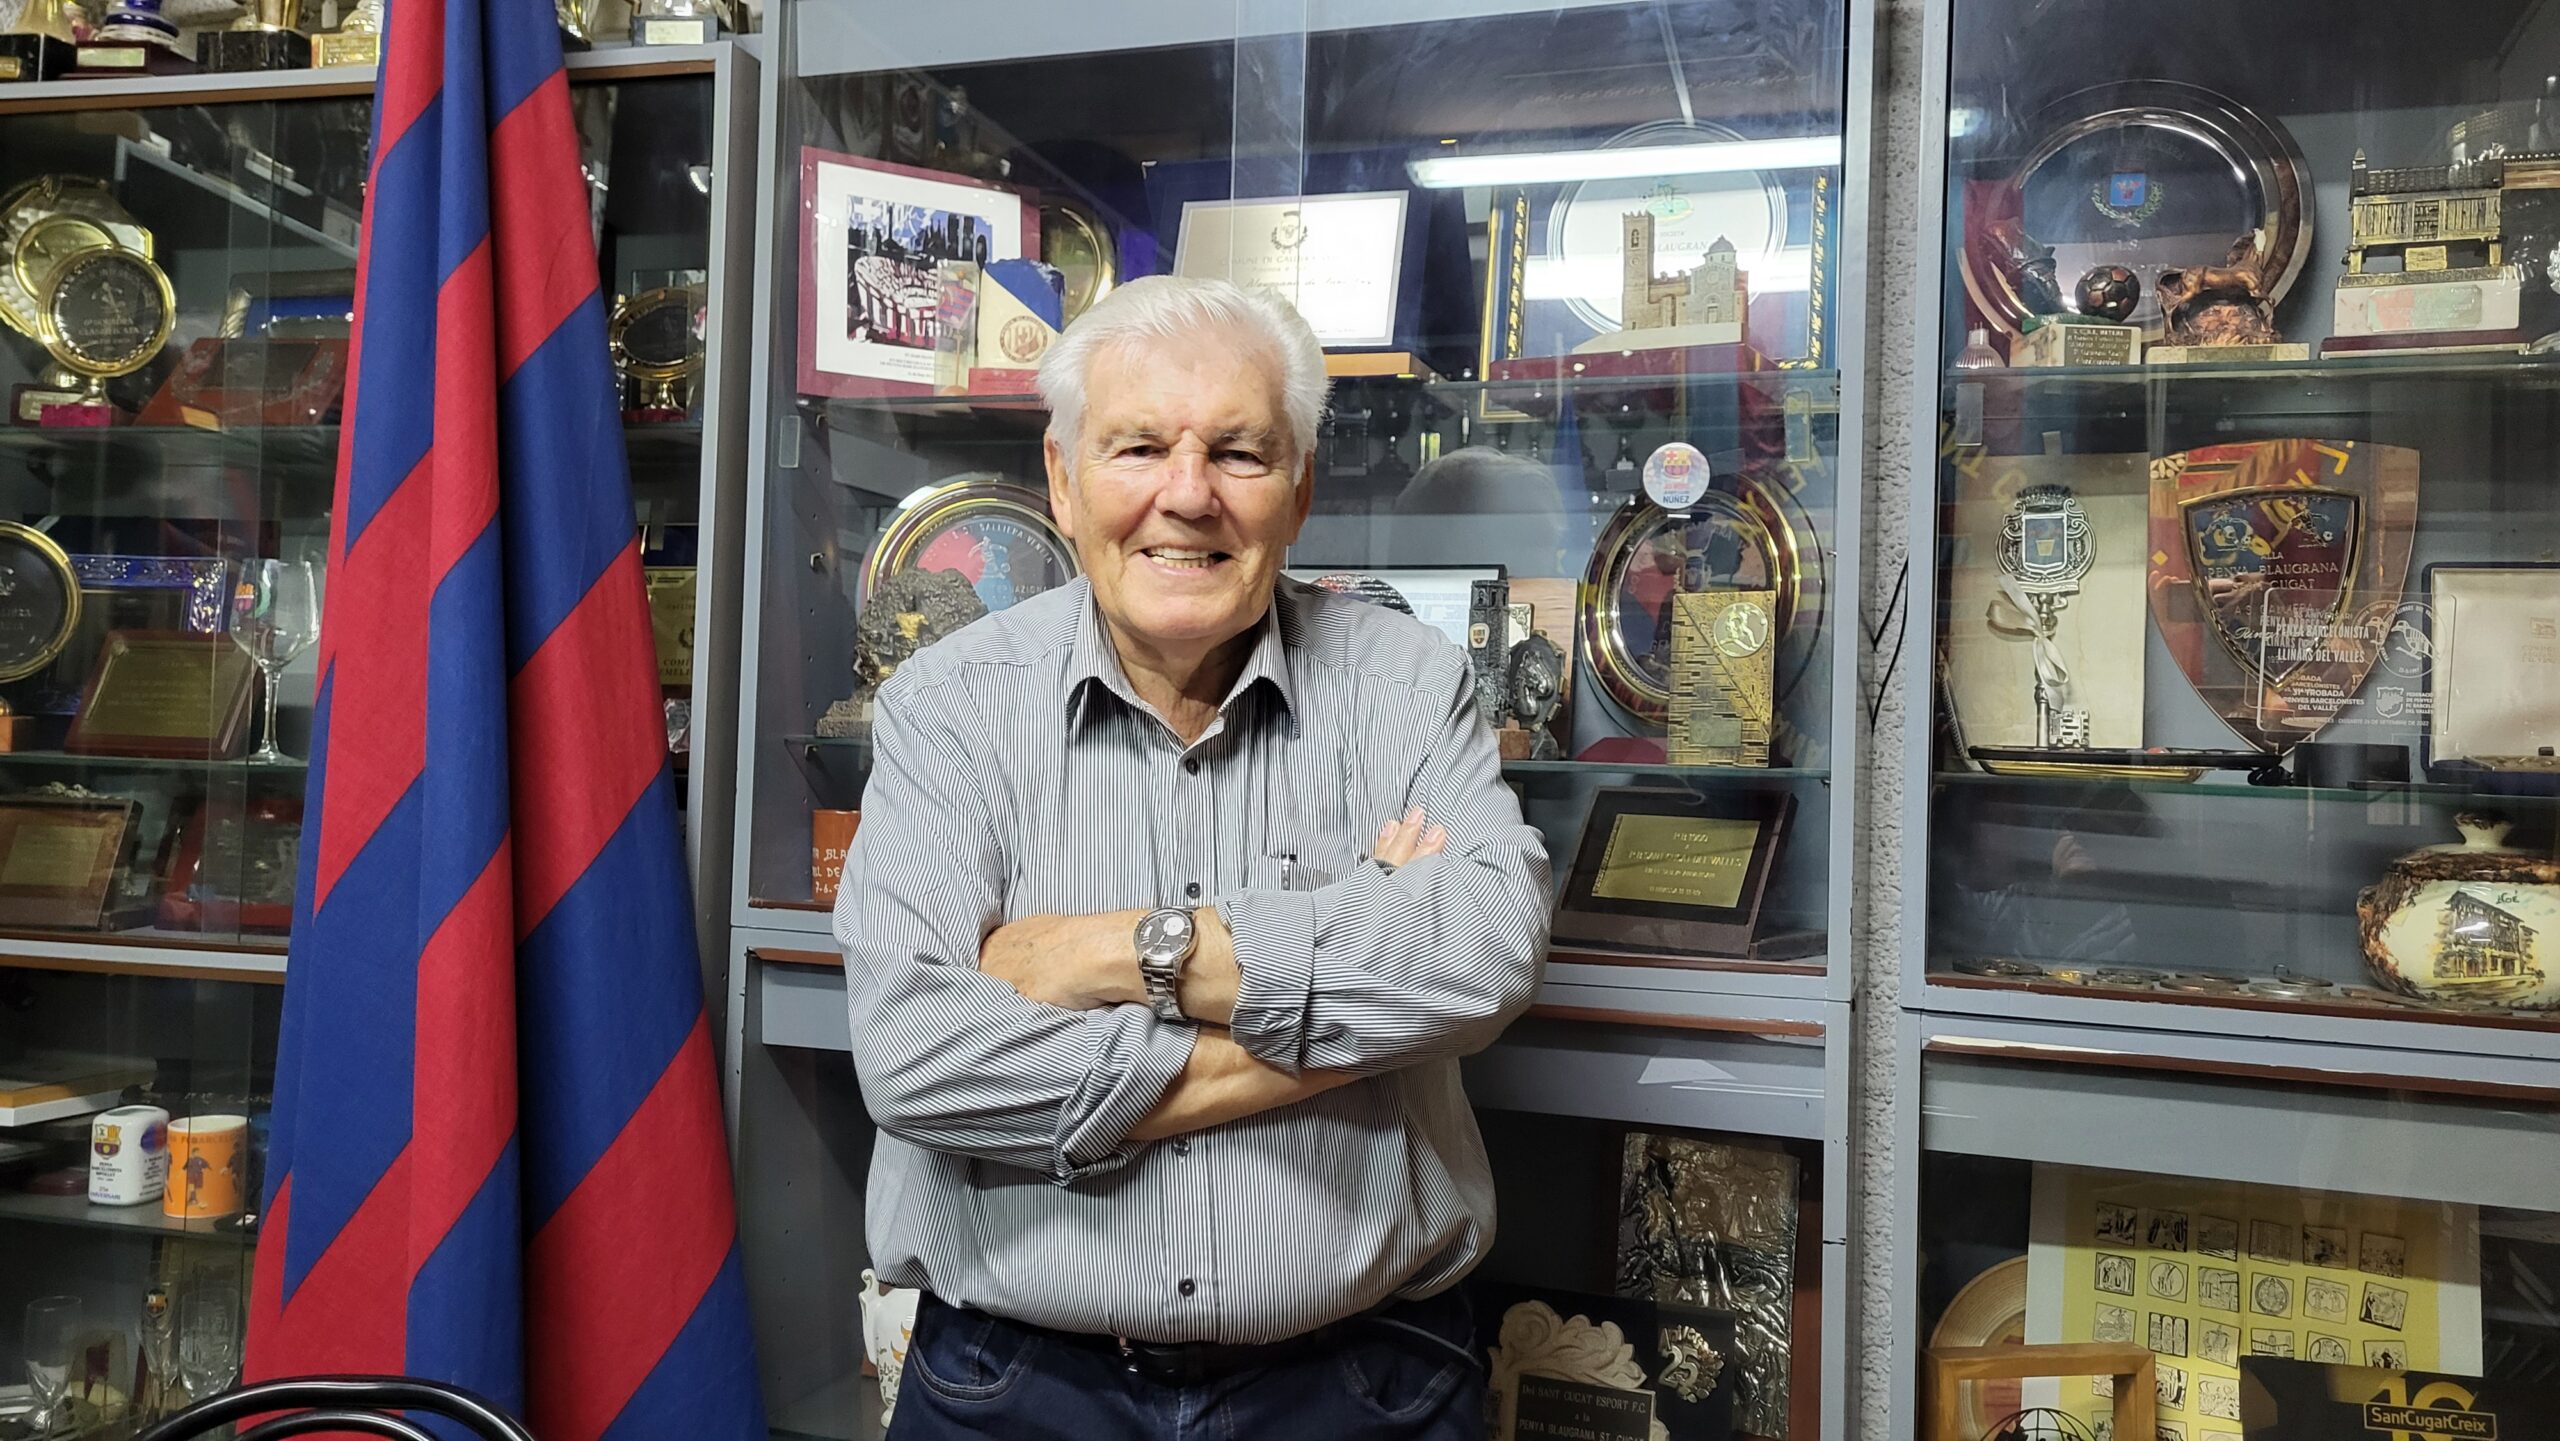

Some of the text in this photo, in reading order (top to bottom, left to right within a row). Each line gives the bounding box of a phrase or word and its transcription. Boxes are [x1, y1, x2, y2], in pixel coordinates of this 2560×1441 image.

[1656, 240, 1710, 252] LAUGRAN
[2258, 562, 2340, 576] BLAUGRANA
[2306, 625, 2370, 640] BARCELONISTA
[2277, 647, 2314, 662] LLINARS
[2315, 649, 2332, 663] DEL
[2306, 690, 2345, 698] TROBADA
[2310, 698, 2365, 706] BARCELONISTES
[1658, 1344, 1699, 1390] 25
[1595, 1396, 1630, 1410] ESPORT
[2371, 1406, 2488, 1434] SantCugatCreix
[1518, 1418, 1545, 1432] PENYA
[1547, 1424, 1596, 1441] BLAUGRANA
